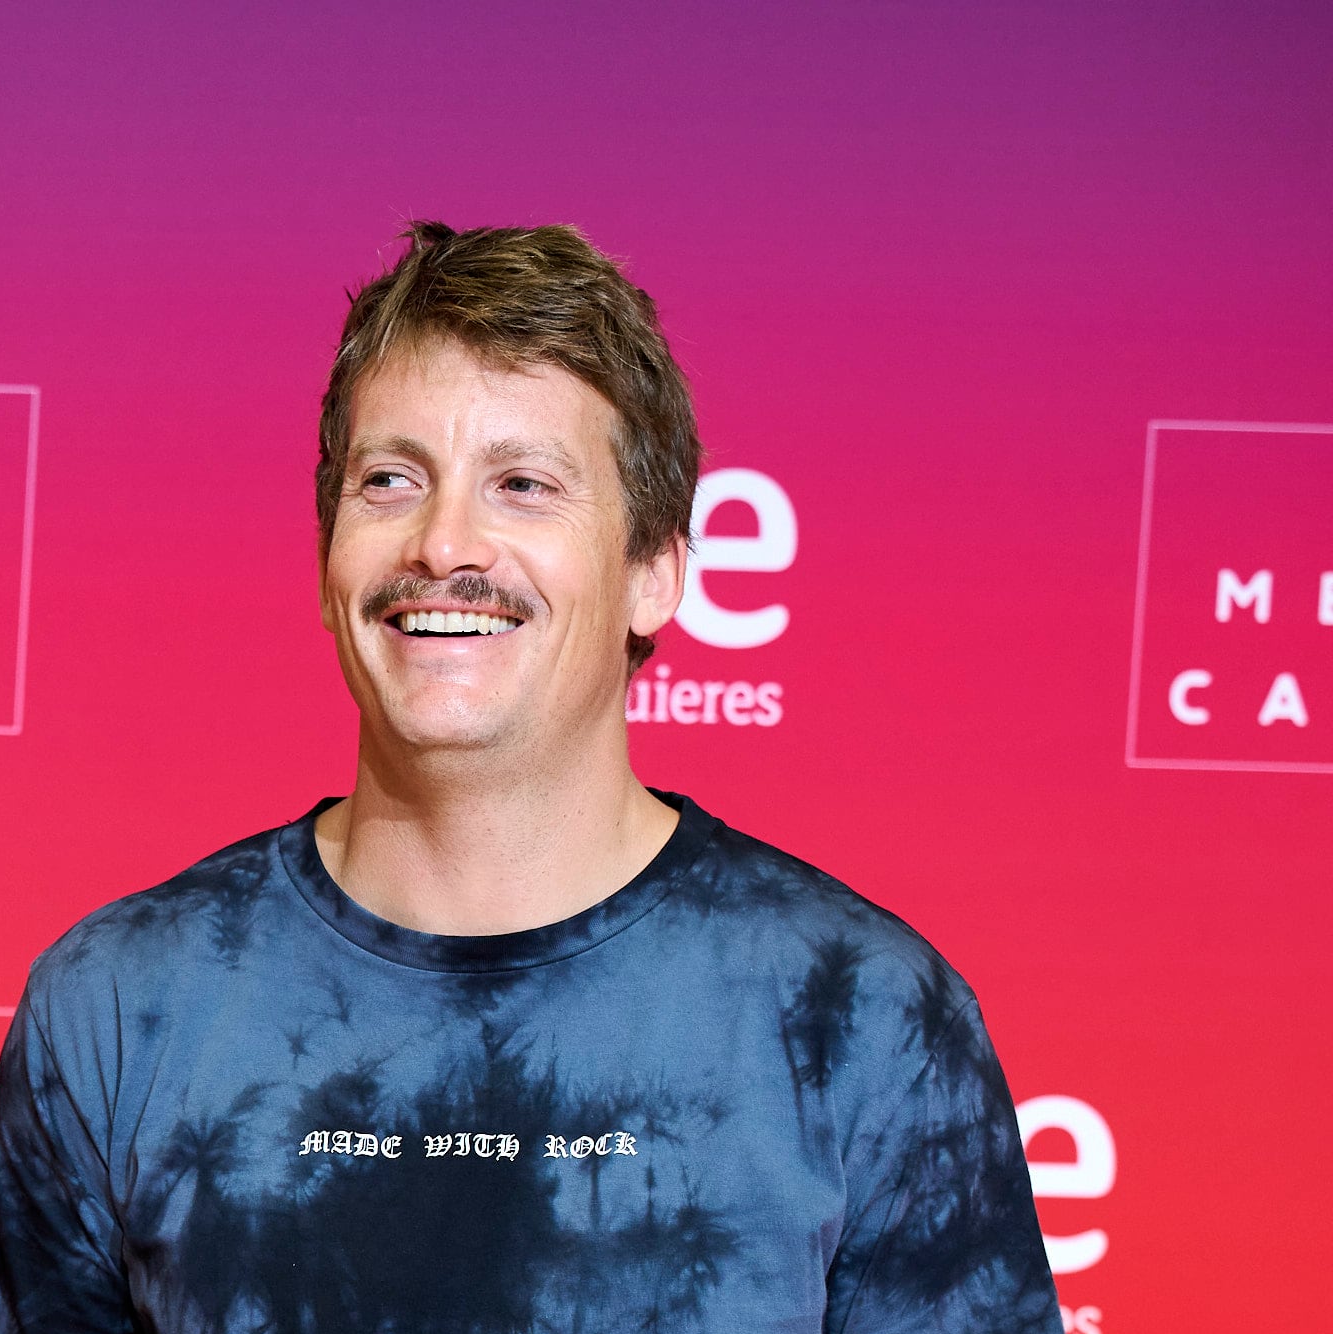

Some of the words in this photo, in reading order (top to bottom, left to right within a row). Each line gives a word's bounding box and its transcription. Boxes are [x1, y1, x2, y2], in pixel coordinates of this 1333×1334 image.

[625, 663, 784, 728] uieres
[297, 1129, 404, 1160] MADE
[422, 1131, 521, 1163] WITH
[541, 1130, 640, 1160] ROCK
